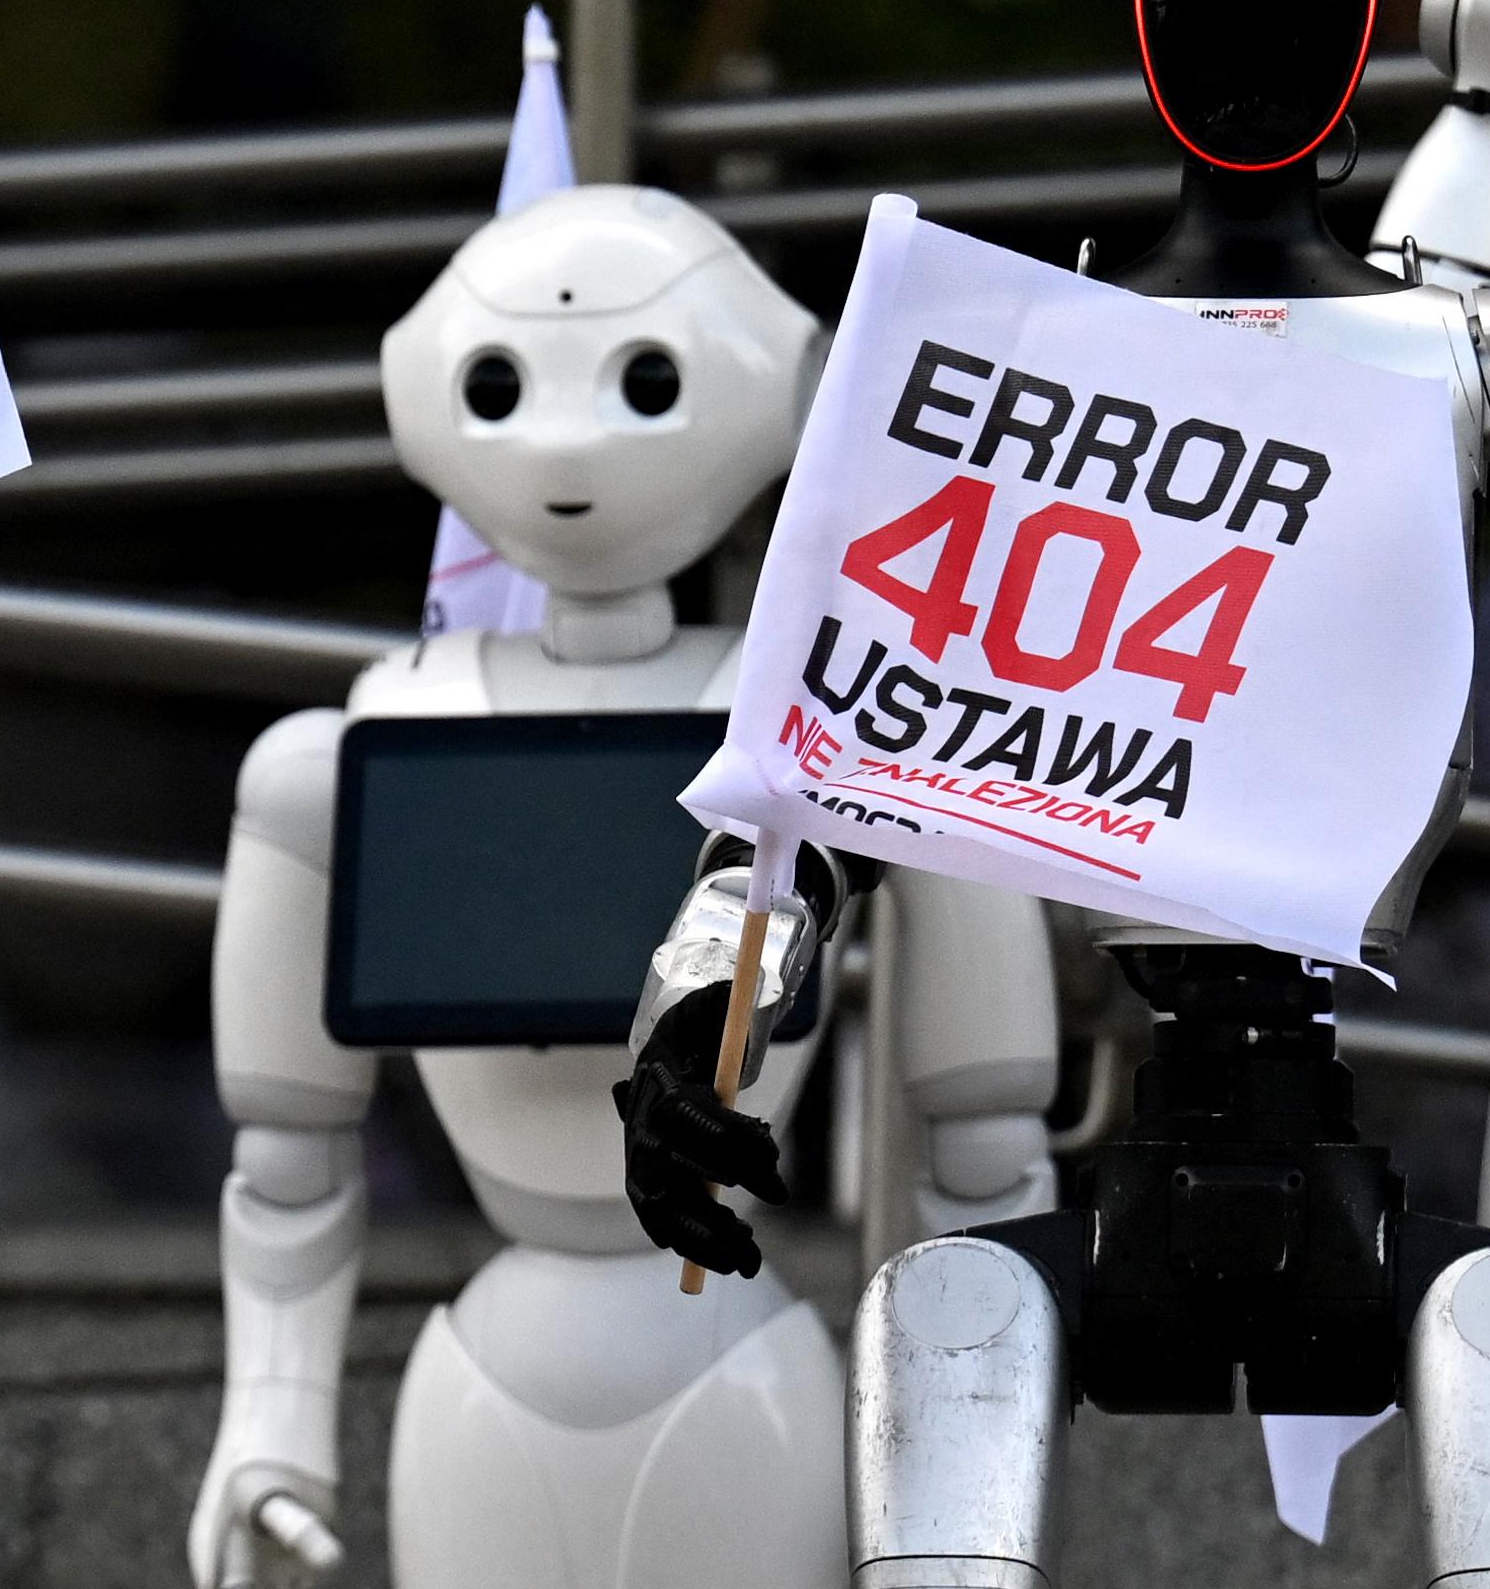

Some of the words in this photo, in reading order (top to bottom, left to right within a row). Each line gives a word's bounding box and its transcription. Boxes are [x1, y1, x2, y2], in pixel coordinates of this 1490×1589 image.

[1200, 309, 1279, 319] INNPRO
[887, 340, 1331, 545] ERROR
[840, 475, 1274, 723] 404
[802, 616, 1192, 819] USTAWA
